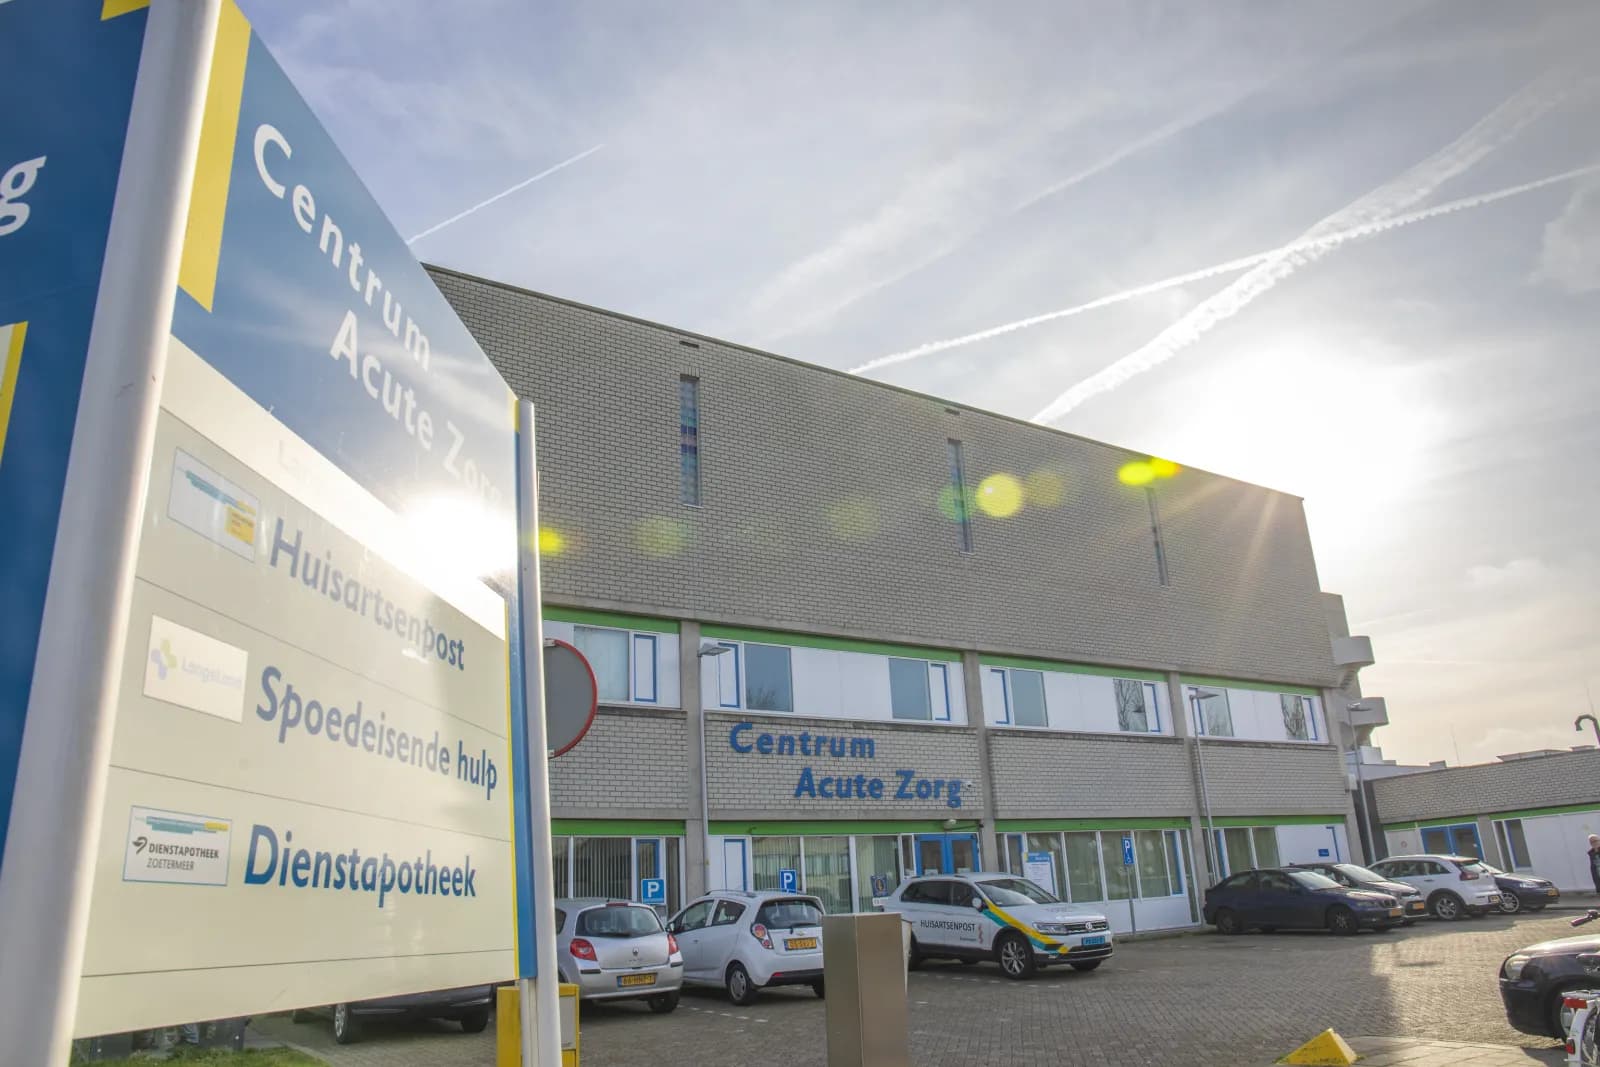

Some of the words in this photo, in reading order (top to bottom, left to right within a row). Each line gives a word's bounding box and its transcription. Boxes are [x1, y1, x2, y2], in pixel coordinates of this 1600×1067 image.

[253, 123, 432, 371] Centrum
[329, 309, 434, 450] Acute
[443, 420, 504, 508] Zor
[270, 516, 465, 671] Huisartsenpost
[255, 666, 451, 776] Spoedeisende
[457, 740, 498, 801] hulp
[729, 722, 876, 758] Centrum
[793, 767, 884, 800] Acute
[894, 770, 963, 808] Zorg
[146, 857, 195, 871] ZOETERMEER
[148, 843, 219, 859] DIENSTAPOTHEEK
[244, 824, 477, 908] Dienstapotheek
[647, 881, 660, 898] P
[920, 920, 976, 932] HUISARTSENPOST
